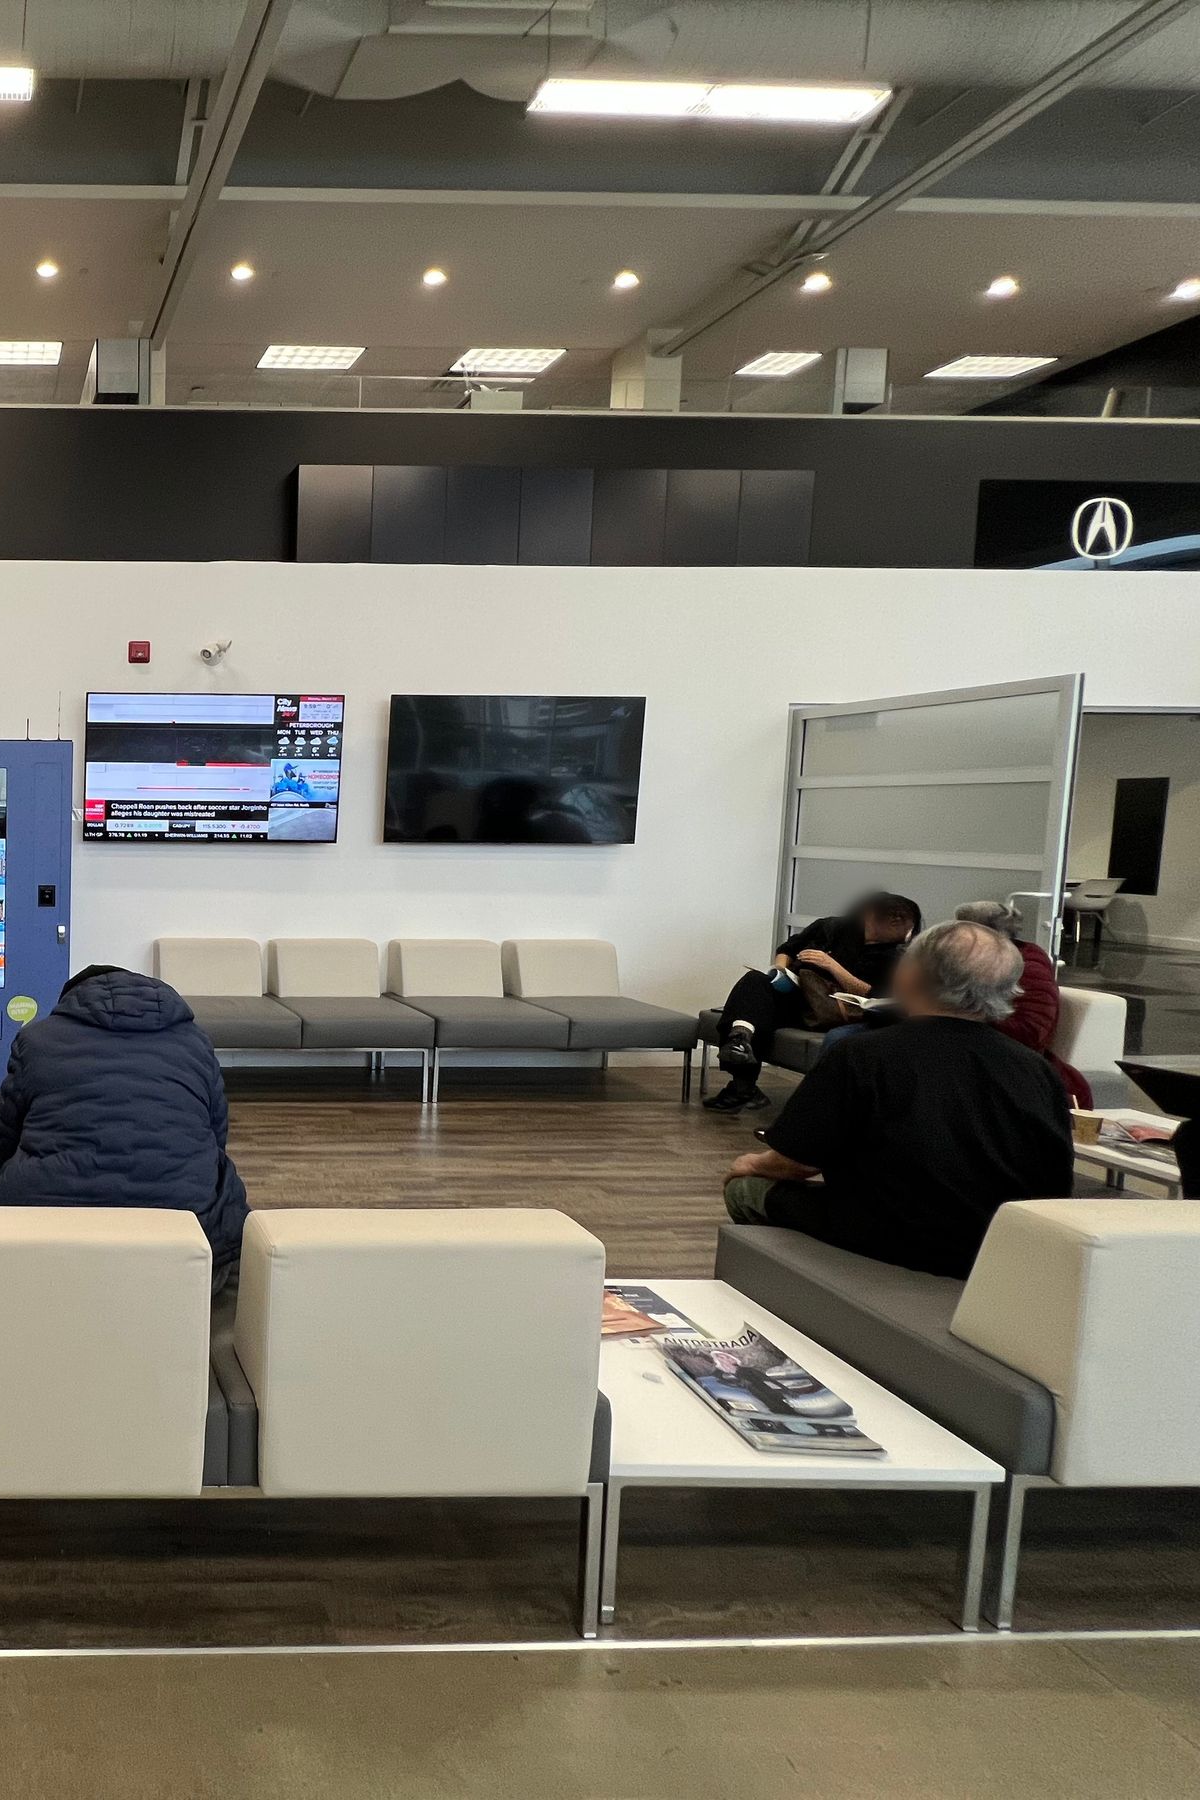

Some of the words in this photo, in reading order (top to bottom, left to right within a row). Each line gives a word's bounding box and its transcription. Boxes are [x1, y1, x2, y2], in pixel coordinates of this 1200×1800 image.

[277, 697, 292, 707] City
[155, 803, 177, 811] pushes
[177, 803, 193, 811] back
[241, 804, 267, 812] Jorginho
[664, 1329, 758, 1350] AUTOSTRADA
